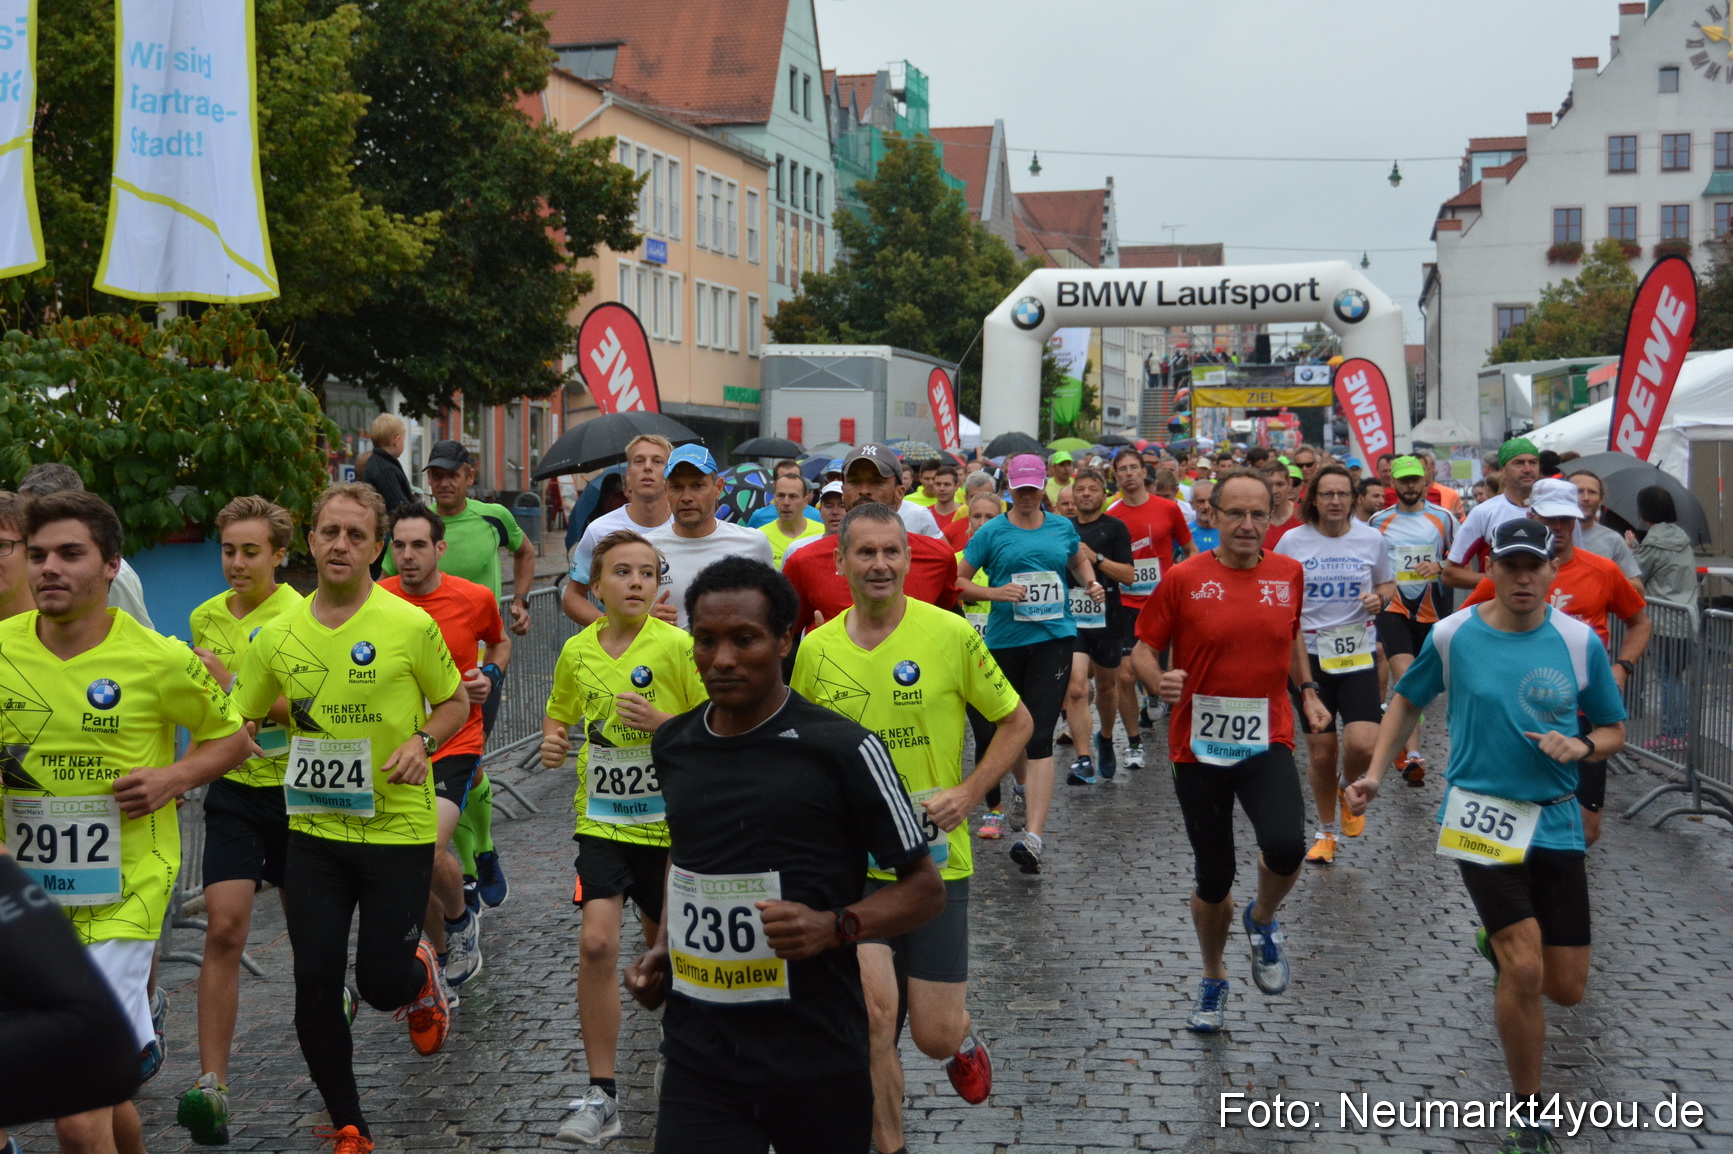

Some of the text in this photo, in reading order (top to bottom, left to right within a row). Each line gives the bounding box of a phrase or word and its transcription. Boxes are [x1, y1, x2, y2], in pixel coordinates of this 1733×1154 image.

[1056, 277, 1320, 310] BMW Laufsport
[1616, 285, 1686, 459] REWE
[1247, 392, 1278, 403] ZIEL
[1133, 567, 1157, 582] 588
[1190, 591, 1212, 600] Spitz
[1306, 582, 1361, 598] 2015
[1335, 636, 1355, 654] 65
[349, 669, 376, 679] Partl
[893, 689, 922, 700] Partl
[321, 704, 367, 714] THE NEXT
[82, 712, 120, 728] Partl
[330, 713, 383, 724] 100 YEARS
[82, 725, 118, 734] Neumarkt
[612, 725, 629, 733] THE
[888, 726, 915, 739] NEXT
[1200, 712, 1261, 740] 2792
[621, 731, 655, 741] 100 YEA
[898, 736, 930, 748] YEARS
[320, 741, 362, 752] BOCK
[1206, 744, 1252, 758] Bernhard
[40, 755, 103, 767] THE NEXT
[53, 769, 121, 781] 100 YEARS
[294, 757, 365, 789] 2824
[594, 763, 662, 795] 2823
[51, 800, 110, 813] BOCK
[307, 793, 352, 807] Thomas
[612, 802, 648, 814] Moritz
[1460, 801, 1517, 841] 355
[16, 822, 109, 864] 2912
[1458, 835, 1501, 857] Thomas
[44, 875, 75, 891] Max
[701, 878, 767, 895] BOCK
[683, 902, 755, 953] 236
[675, 956, 778, 989] Girma Ayalew
